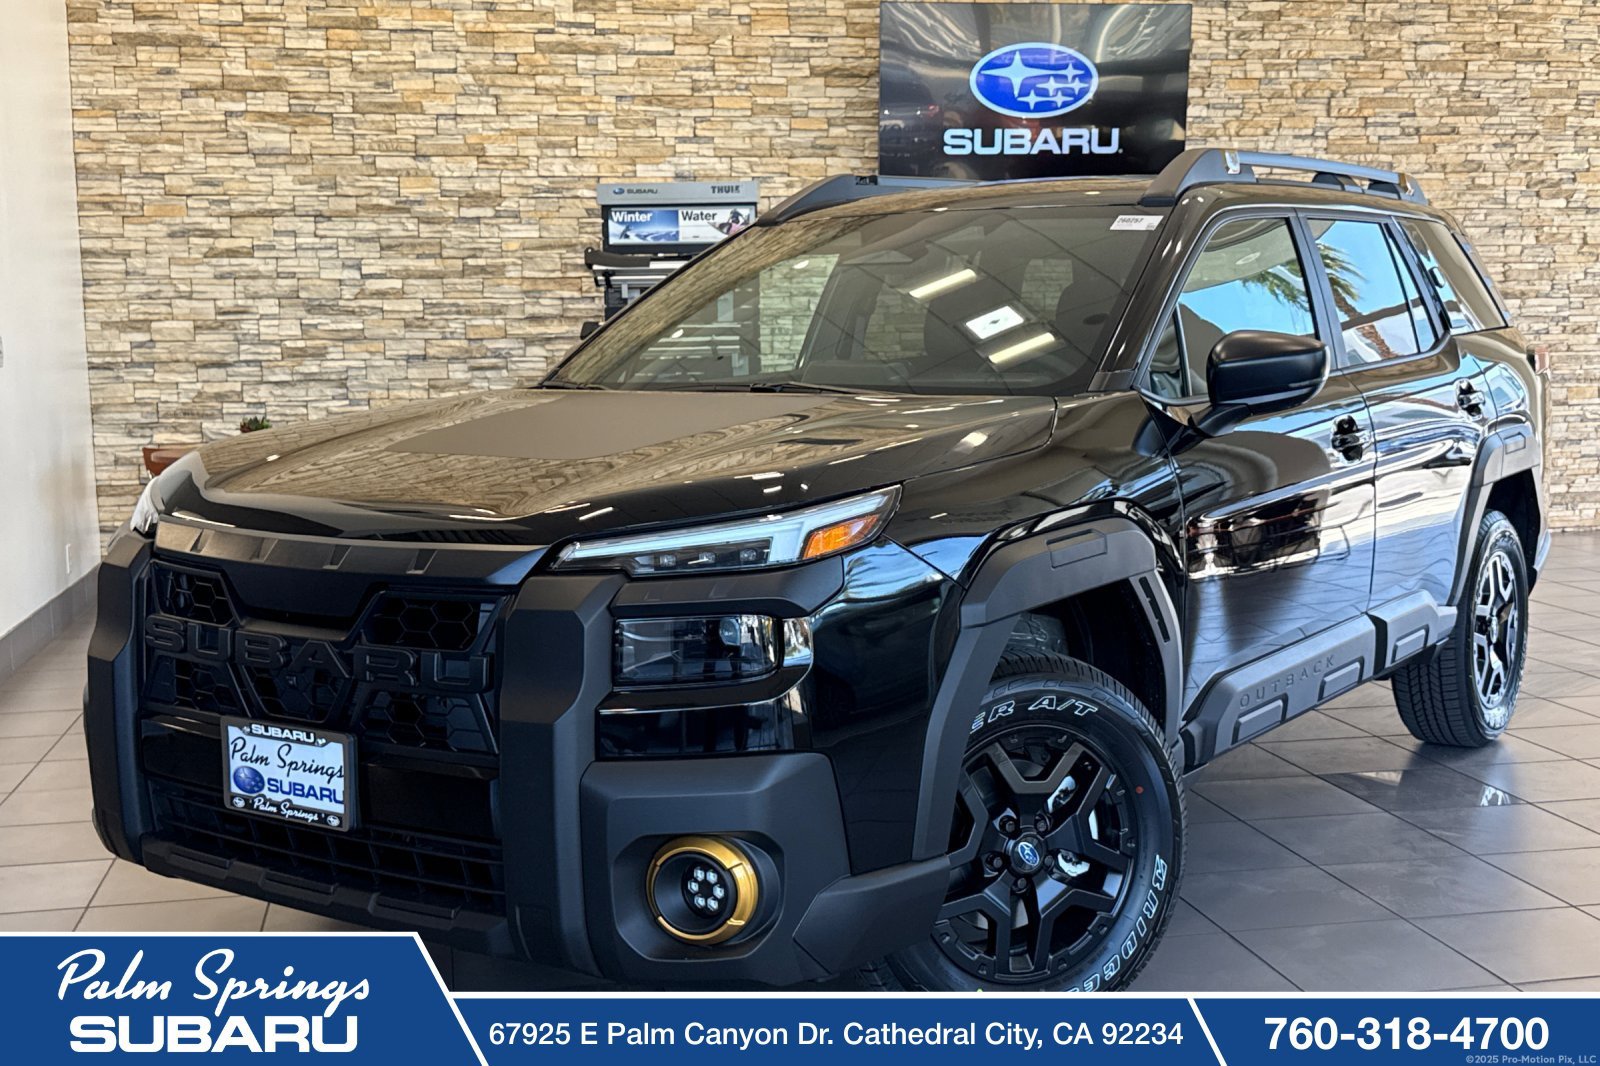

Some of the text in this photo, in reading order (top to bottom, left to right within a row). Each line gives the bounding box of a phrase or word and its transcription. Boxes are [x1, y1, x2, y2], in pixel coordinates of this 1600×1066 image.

[943, 128, 1120, 155] SUBARU
[611, 211, 653, 223] Winter
[682, 211, 717, 221] Water
[145, 614, 495, 694] SUBARU
[1239, 654, 1336, 708] OUTBACK
[1028, 695, 1099, 717] A/T
[251, 723, 315, 743] SUBARU
[230, 736, 345, 784] Palm Springs
[253, 797, 319, 823] Palm Springs
